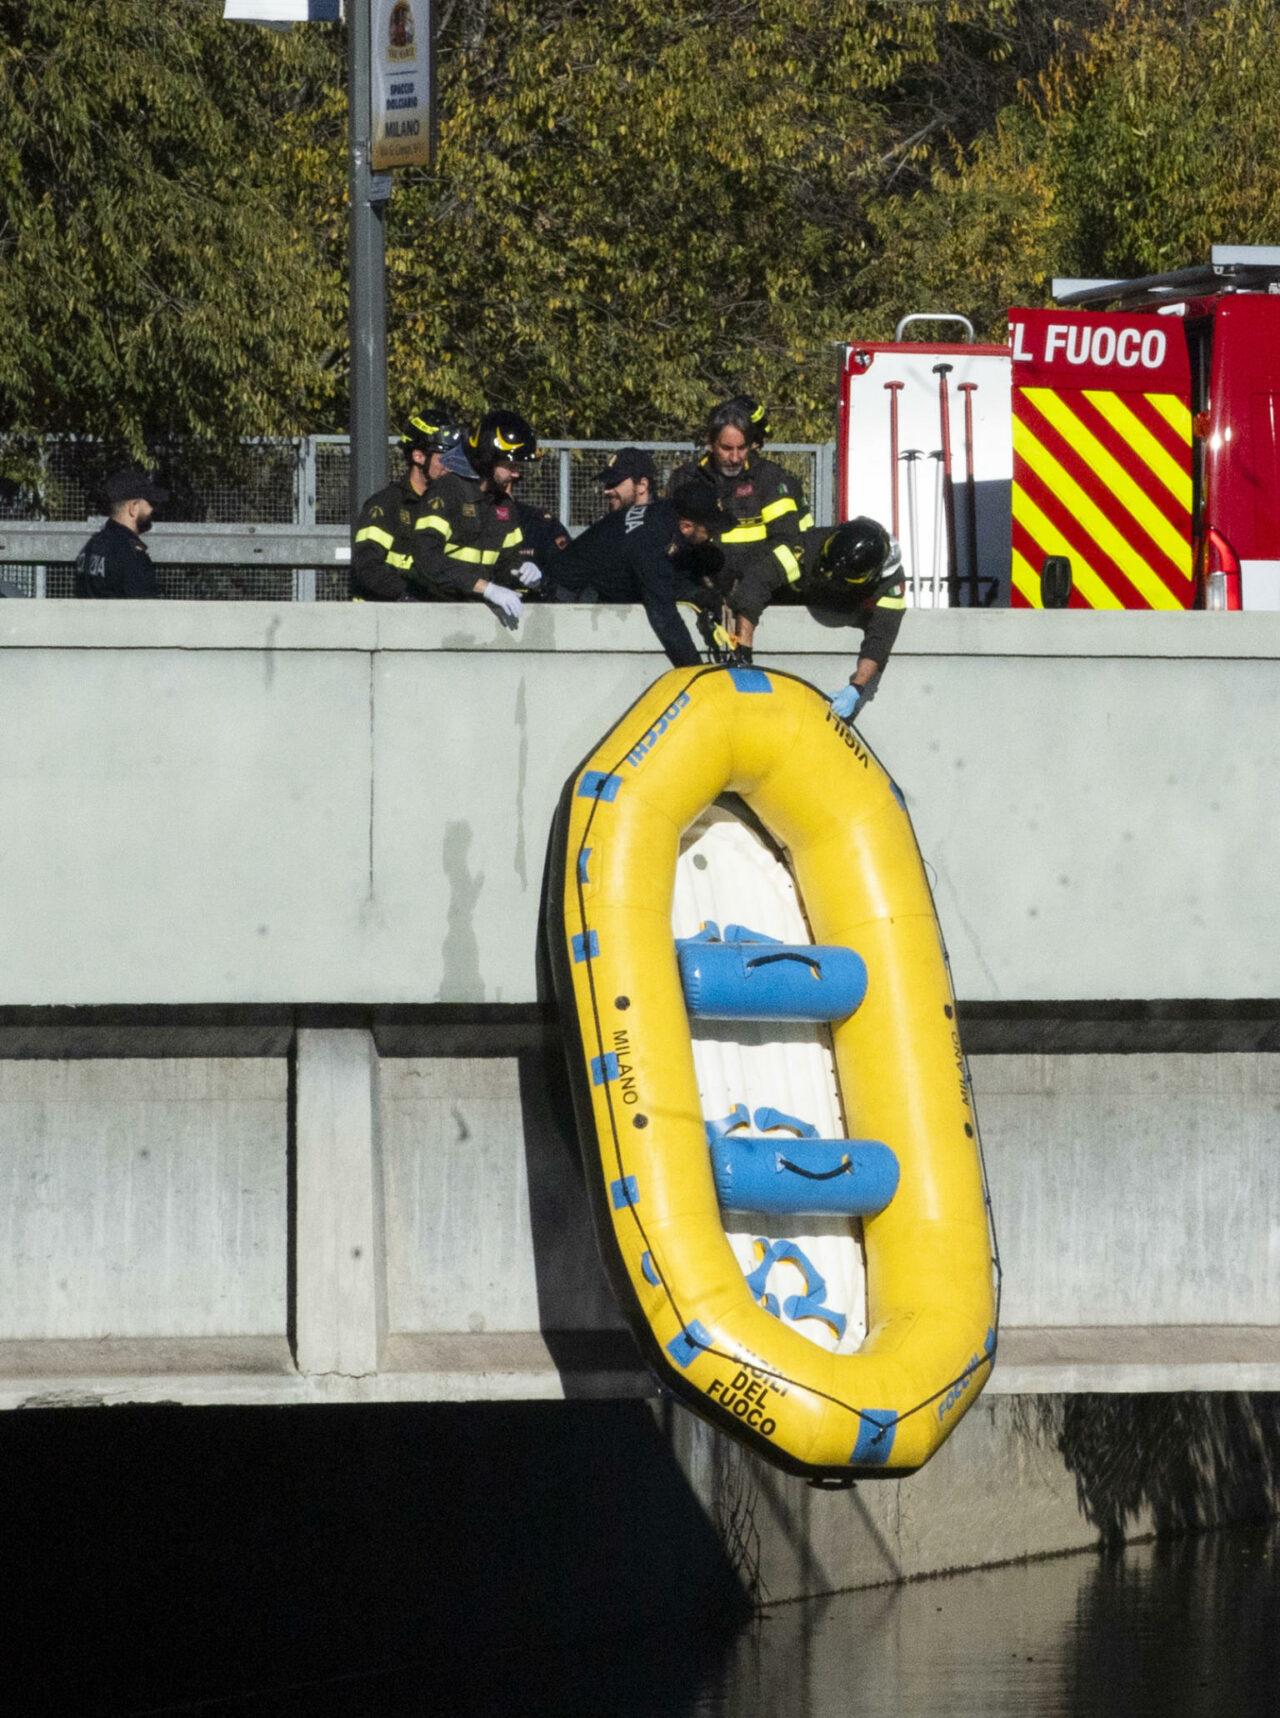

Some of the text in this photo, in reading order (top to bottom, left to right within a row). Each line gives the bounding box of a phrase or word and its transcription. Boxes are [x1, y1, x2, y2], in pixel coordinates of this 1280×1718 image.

[385, 120, 420, 137] MILANO
[1044, 324, 1167, 370] FUOCO
[825, 710, 869, 769] VIGILI
[612, 1029, 639, 1105] MILANO
[705, 1378, 777, 1436] FUOCO
[729, 1370, 769, 1410] DEL
